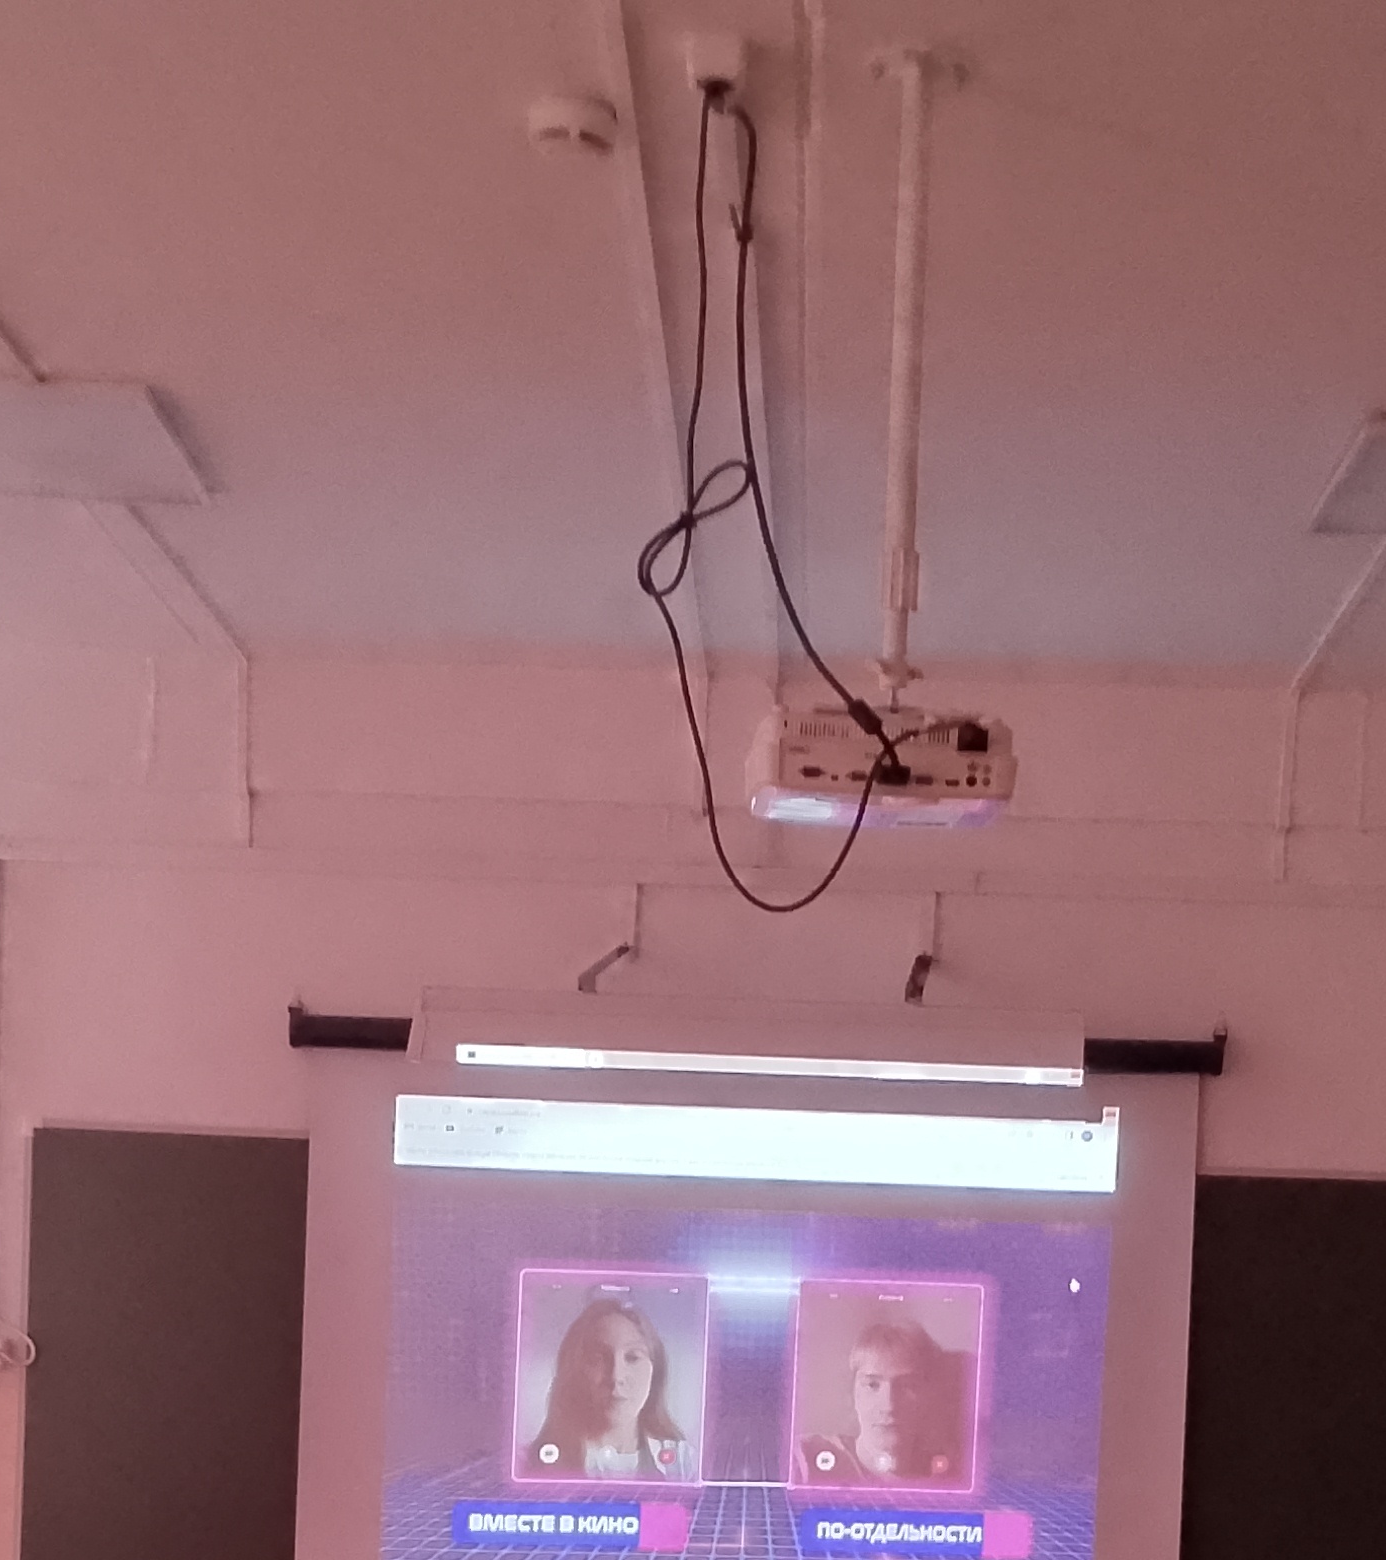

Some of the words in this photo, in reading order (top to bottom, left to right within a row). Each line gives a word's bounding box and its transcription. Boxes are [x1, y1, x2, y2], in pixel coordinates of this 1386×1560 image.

[468, 1512, 556, 1533] ВМЕСТЕ
[559, 1514, 575, 1533] В
[577, 1515, 640, 1535] КИНО
[816, 1521, 983, 1544] ПО-ОТДЕЛЬНОСТИ
